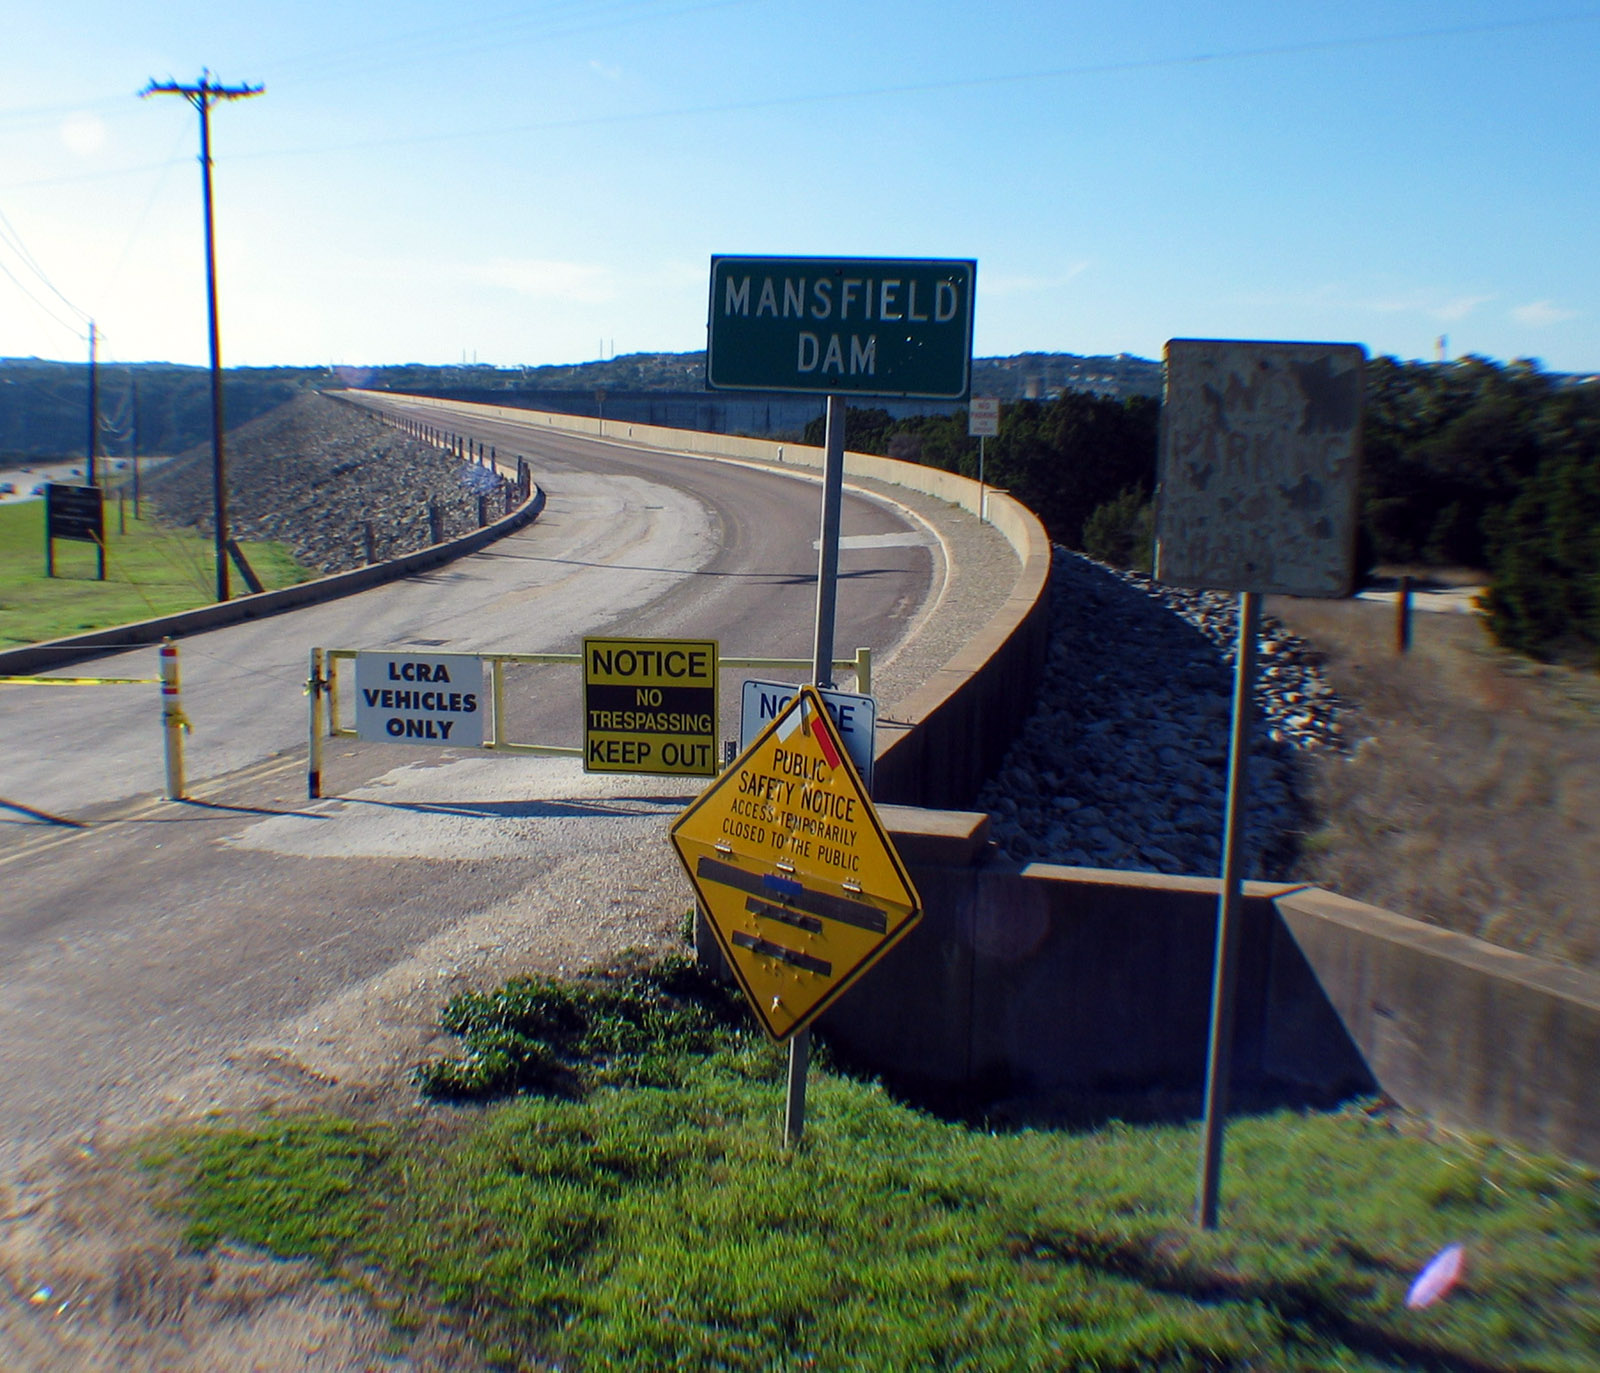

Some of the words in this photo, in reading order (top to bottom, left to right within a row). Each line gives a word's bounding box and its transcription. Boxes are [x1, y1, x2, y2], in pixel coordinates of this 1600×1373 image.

[725, 276, 958, 322] MANSFIELD
[797, 332, 877, 375] DAM
[388, 661, 451, 683] LCRA
[592, 649, 707, 678] NOTICE
[363, 688, 477, 713] VEHICLES
[636, 688, 662, 707] NO
[385, 717, 454, 740] ONLY
[590, 710, 712, 733] TRESPASSING
[590, 739, 650, 765] KEEP
[662, 742, 711, 768] OUT
[772, 748, 827, 782] PUBLIC
[738, 770, 795, 804] SAFETY
[801, 791, 856, 823] NOTICE
[731, 798, 774, 824] ACCESS
[780, 811, 858, 847] TEMPORARILY
[722, 817, 765, 843] CLOSED
[771, 831, 785, 849] TO
[790, 835, 812, 858] THE
[817, 845, 861, 872] PUBLIC
